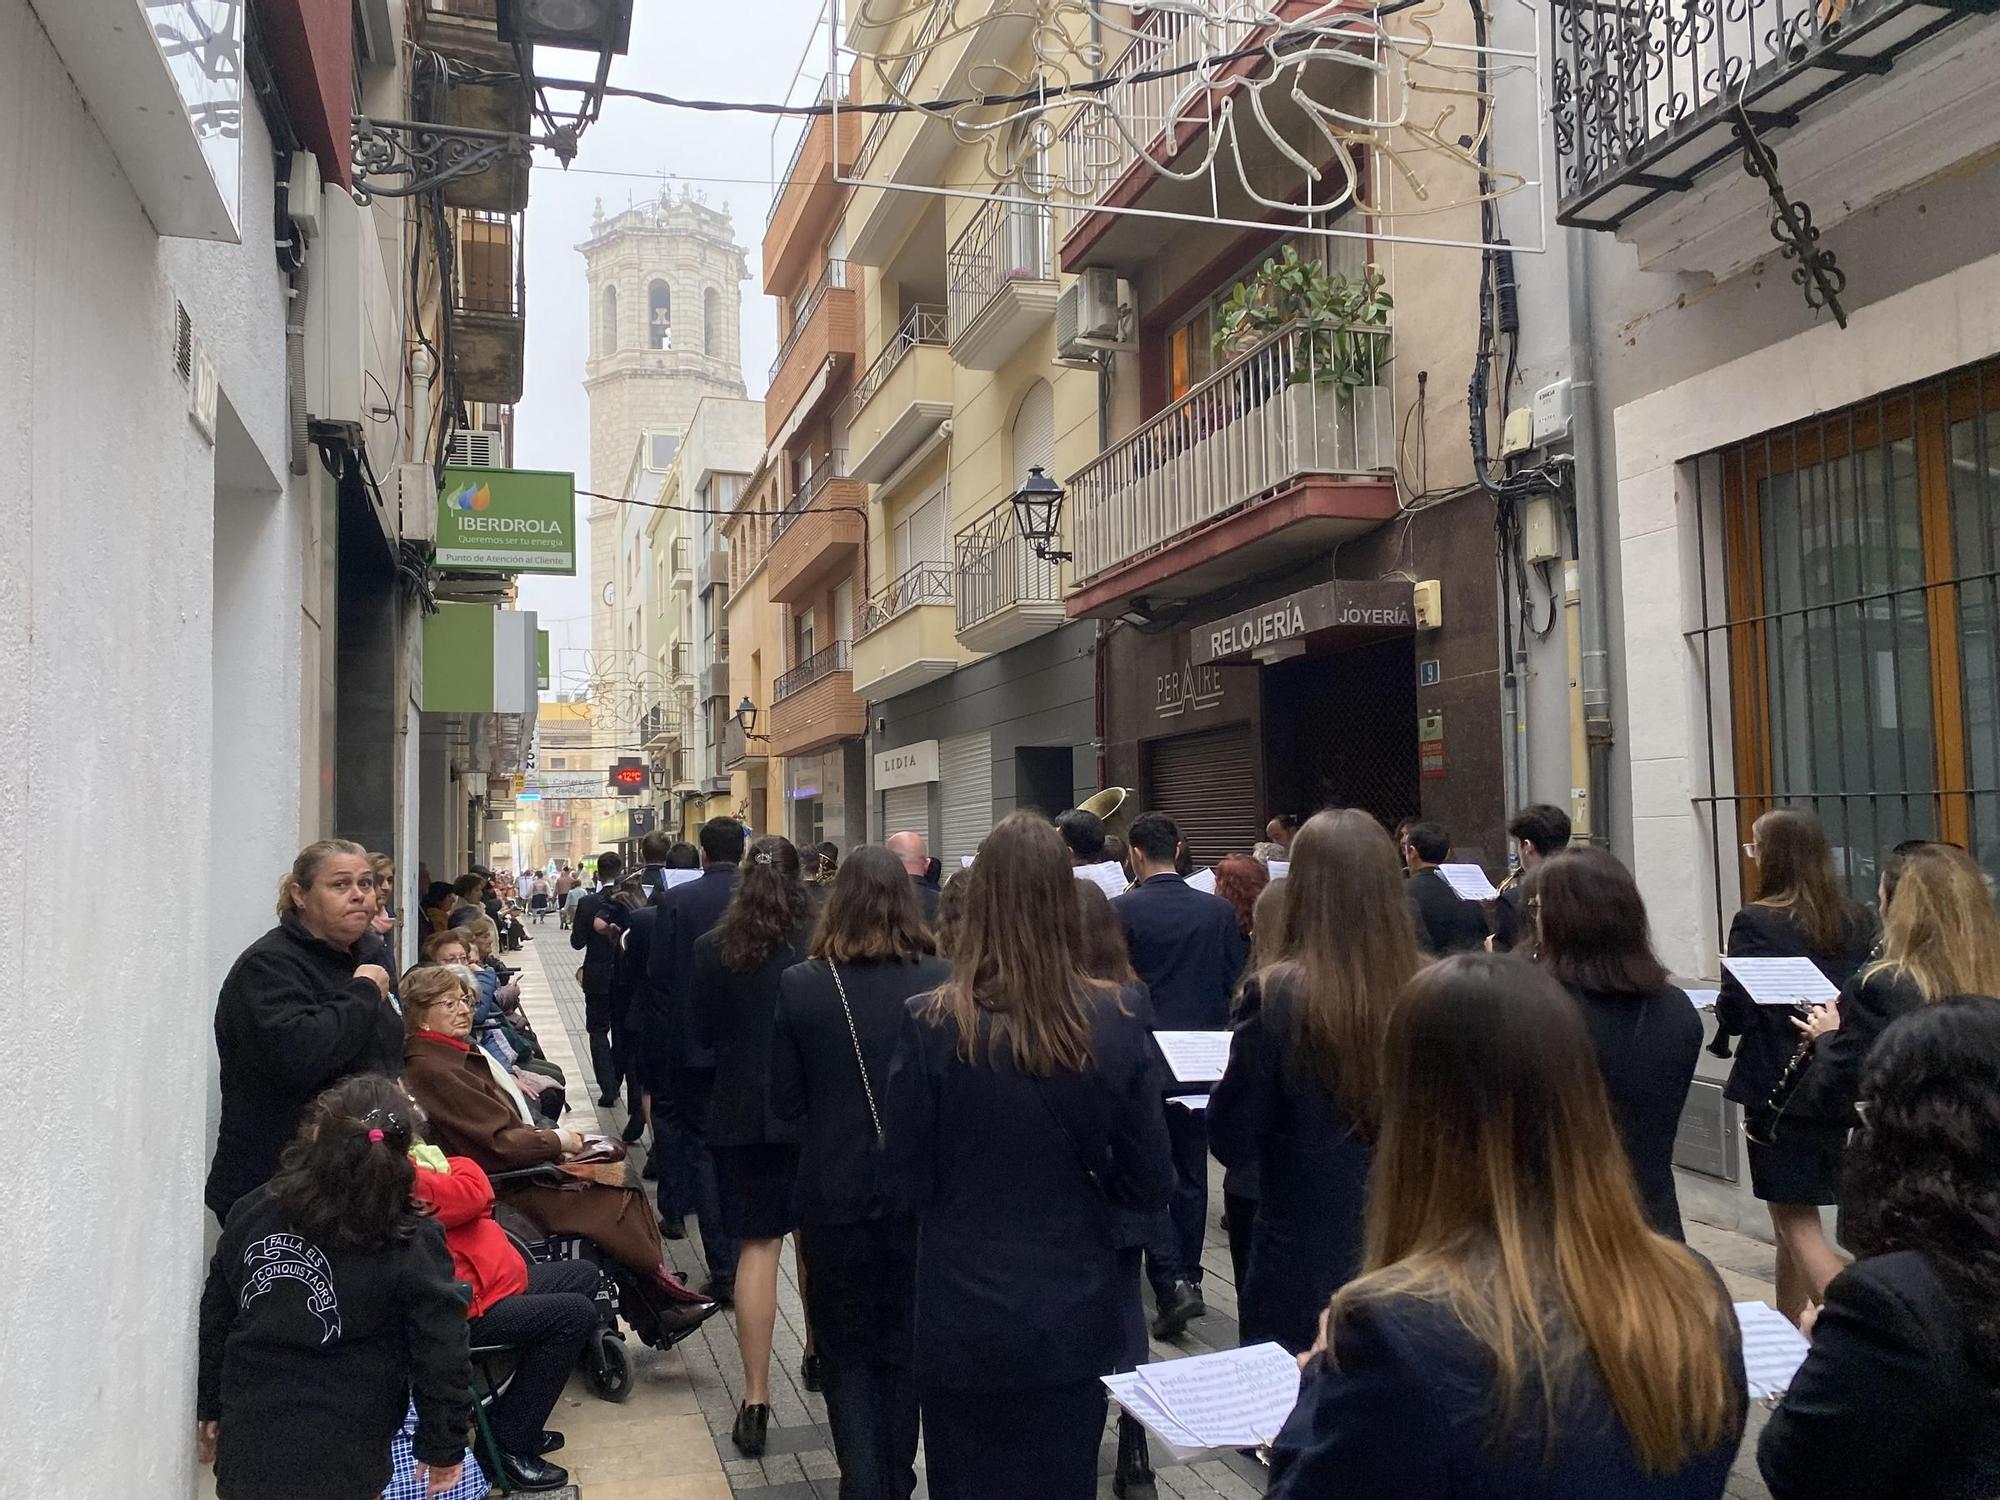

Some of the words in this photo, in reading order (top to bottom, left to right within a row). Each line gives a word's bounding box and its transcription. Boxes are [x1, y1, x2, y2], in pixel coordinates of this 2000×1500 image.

[458, 516, 562, 534] IBERDROLA
[458, 535, 503, 545] Queremos
[505, 537, 518, 545] ser
[520, 537, 530, 545] tu
[531, 537, 563, 548] energía
[446, 553, 472, 562] Punto
[473, 554, 485, 562] de
[486, 554, 525, 563] Atención
[534, 556, 564, 565] Cliente
[1339, 606, 1411, 625] JOYERÍA
[1211, 601, 1305, 658] RELOJERÍA
[1427, 664, 1434, 682] 9
[884, 754, 917, 772] LIDIA
[270, 1236, 303, 1251] FALLA
[305, 1247, 324, 1268] ELS
[257, 1263, 333, 1305] CONQUISTAORS
